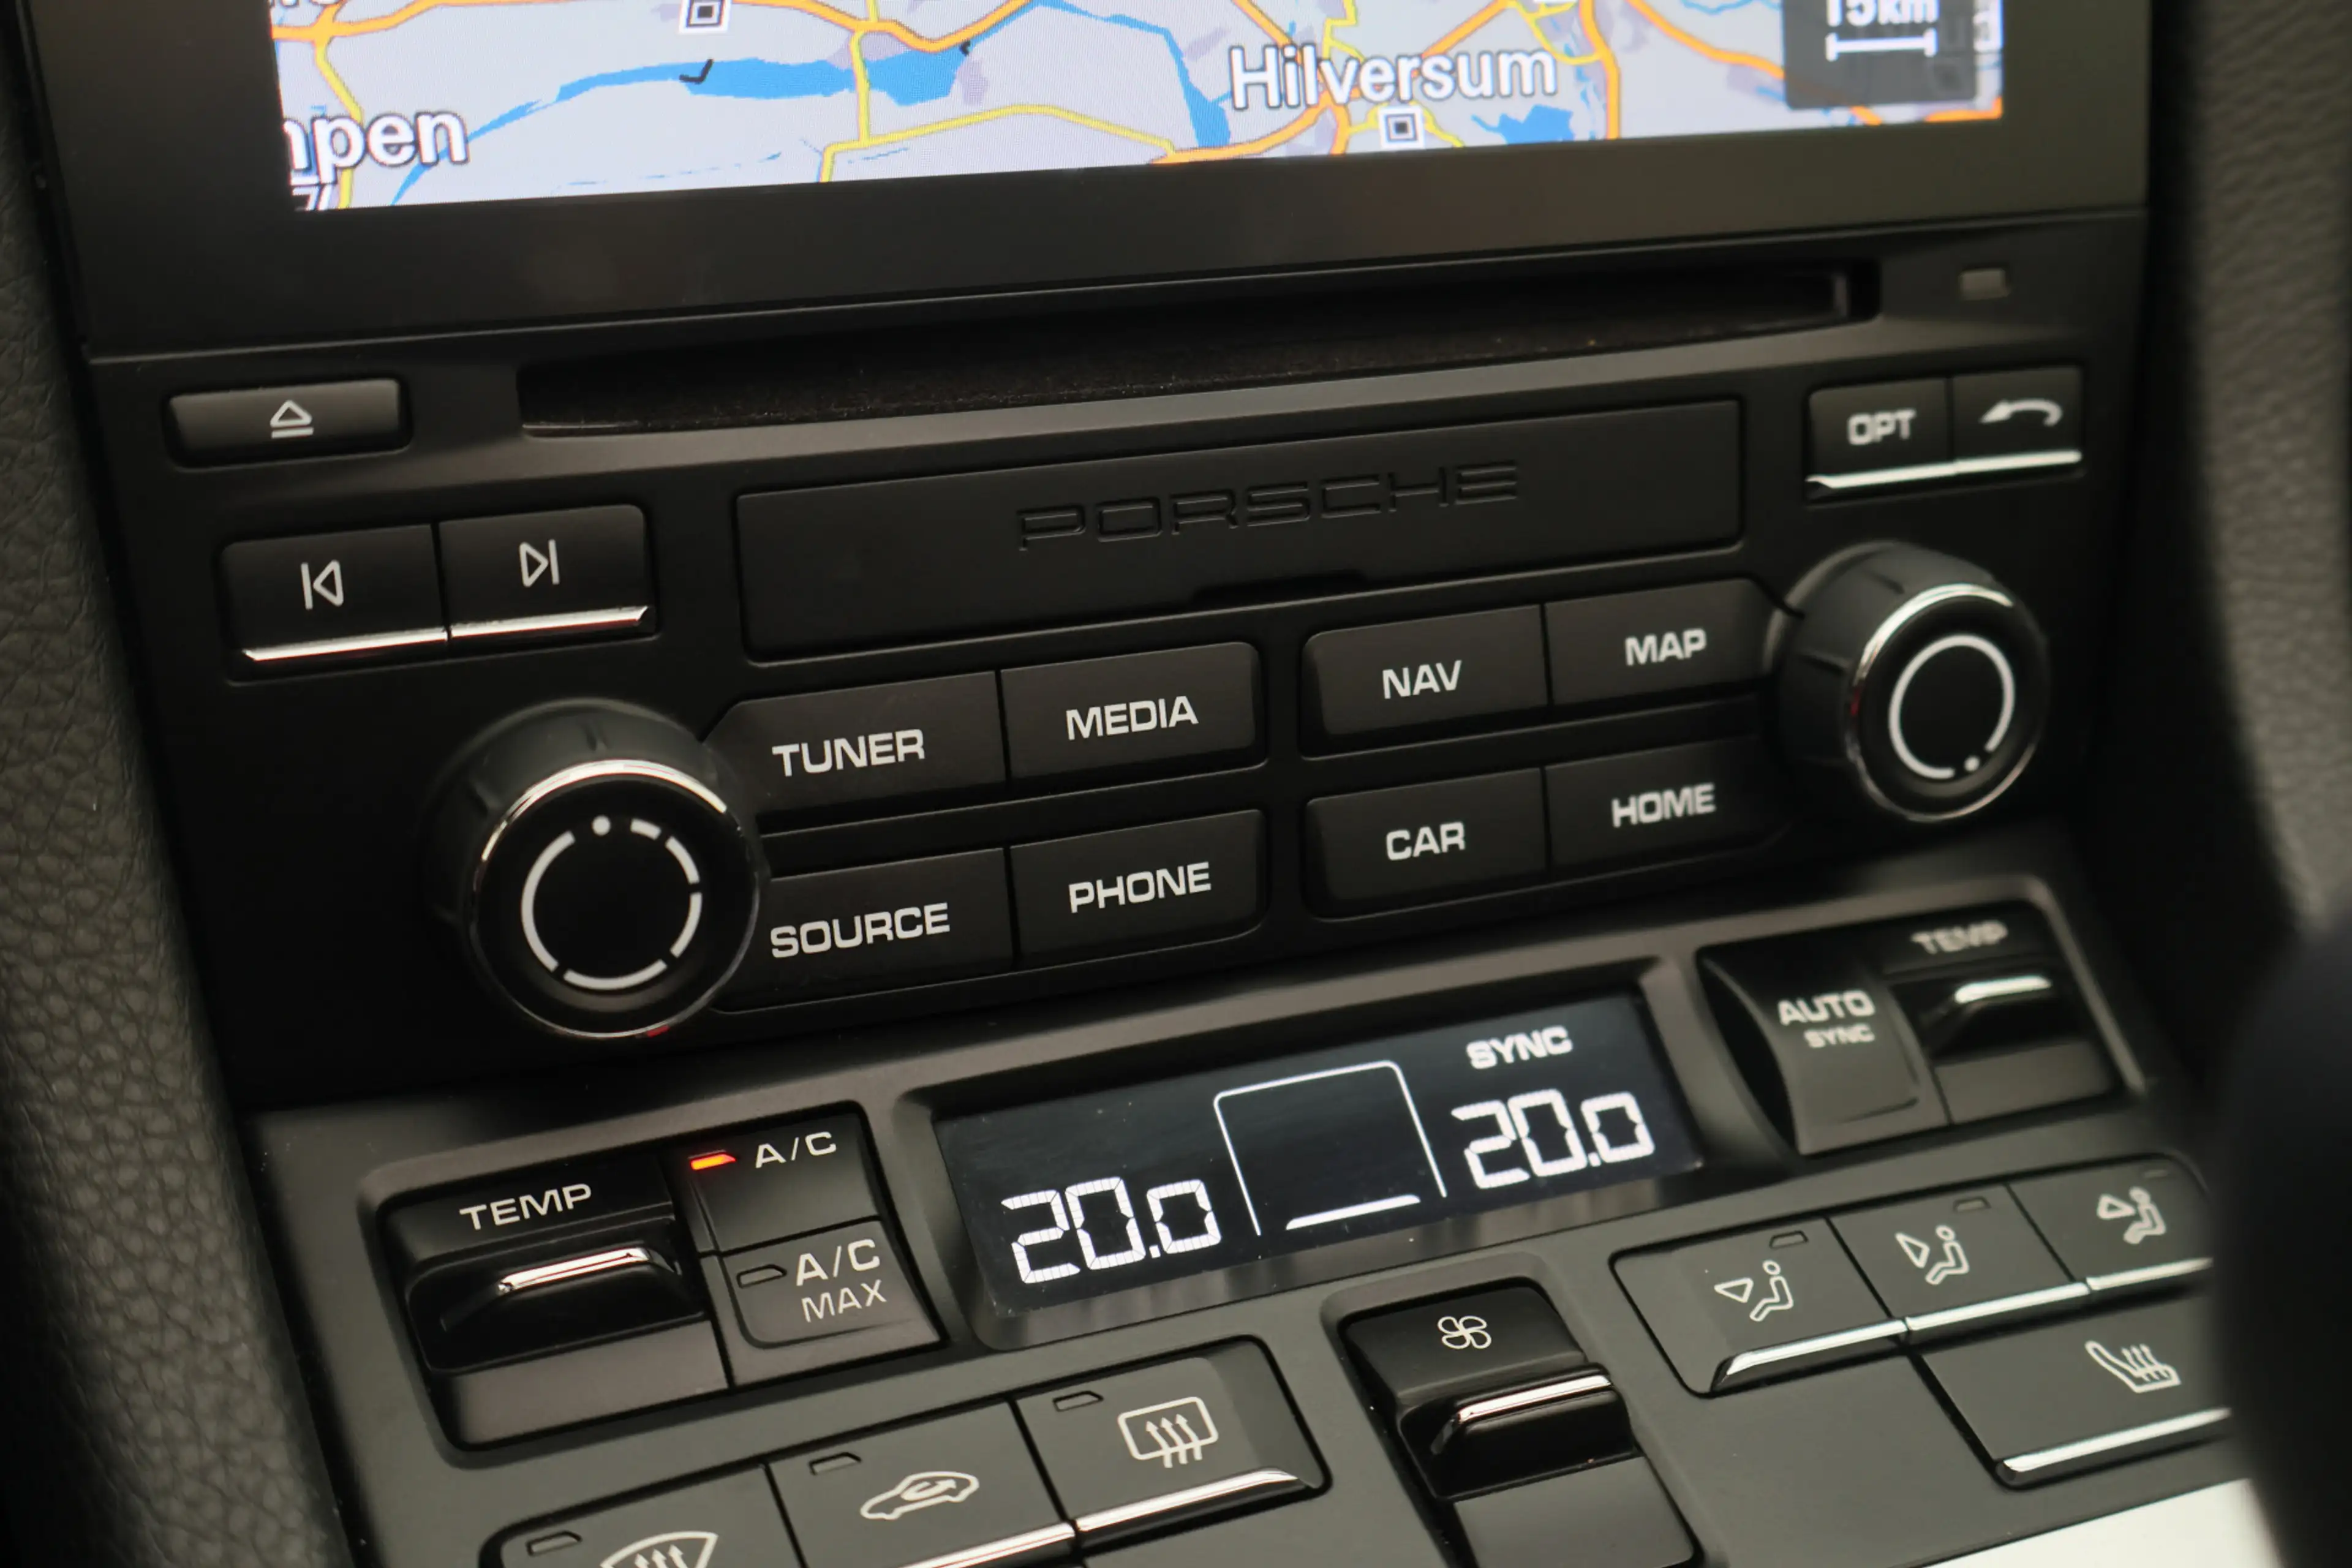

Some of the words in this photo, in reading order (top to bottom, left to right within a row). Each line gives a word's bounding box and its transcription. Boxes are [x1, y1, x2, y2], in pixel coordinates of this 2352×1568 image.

[1229, 44, 1557, 109] Hilversum
[1847, 409, 1916, 445] OPT
[1016, 461, 1518, 551] PORSCHE
[1625, 628, 1706, 666] MAP
[1382, 660, 1462, 699] NAV
[1066, 695, 1199, 741] MEDIA
[772, 729, 925, 777] TUNER
[1611, 783, 1716, 827] HOME
[1386, 821, 1466, 861] CAR
[1068, 862, 1212, 913] PHONE
[771, 902, 951, 958] SOURCE
[1912, 921, 2008, 954] TEMP
[1778, 990, 1875, 1025] AUTO
[1466, 1026, 1573, 1069] SYNC
[1804, 1023, 1875, 1048] SYNC
[755, 1131, 837, 1169] A/C
[1451, 1088, 1656, 1189] 20.0
[459, 1183, 592, 1230] TEMP
[1001, 1176, 1222, 1284] 20.0
[795, 1238, 881, 1286] A/C
[801, 1279, 887, 1322] MAX
